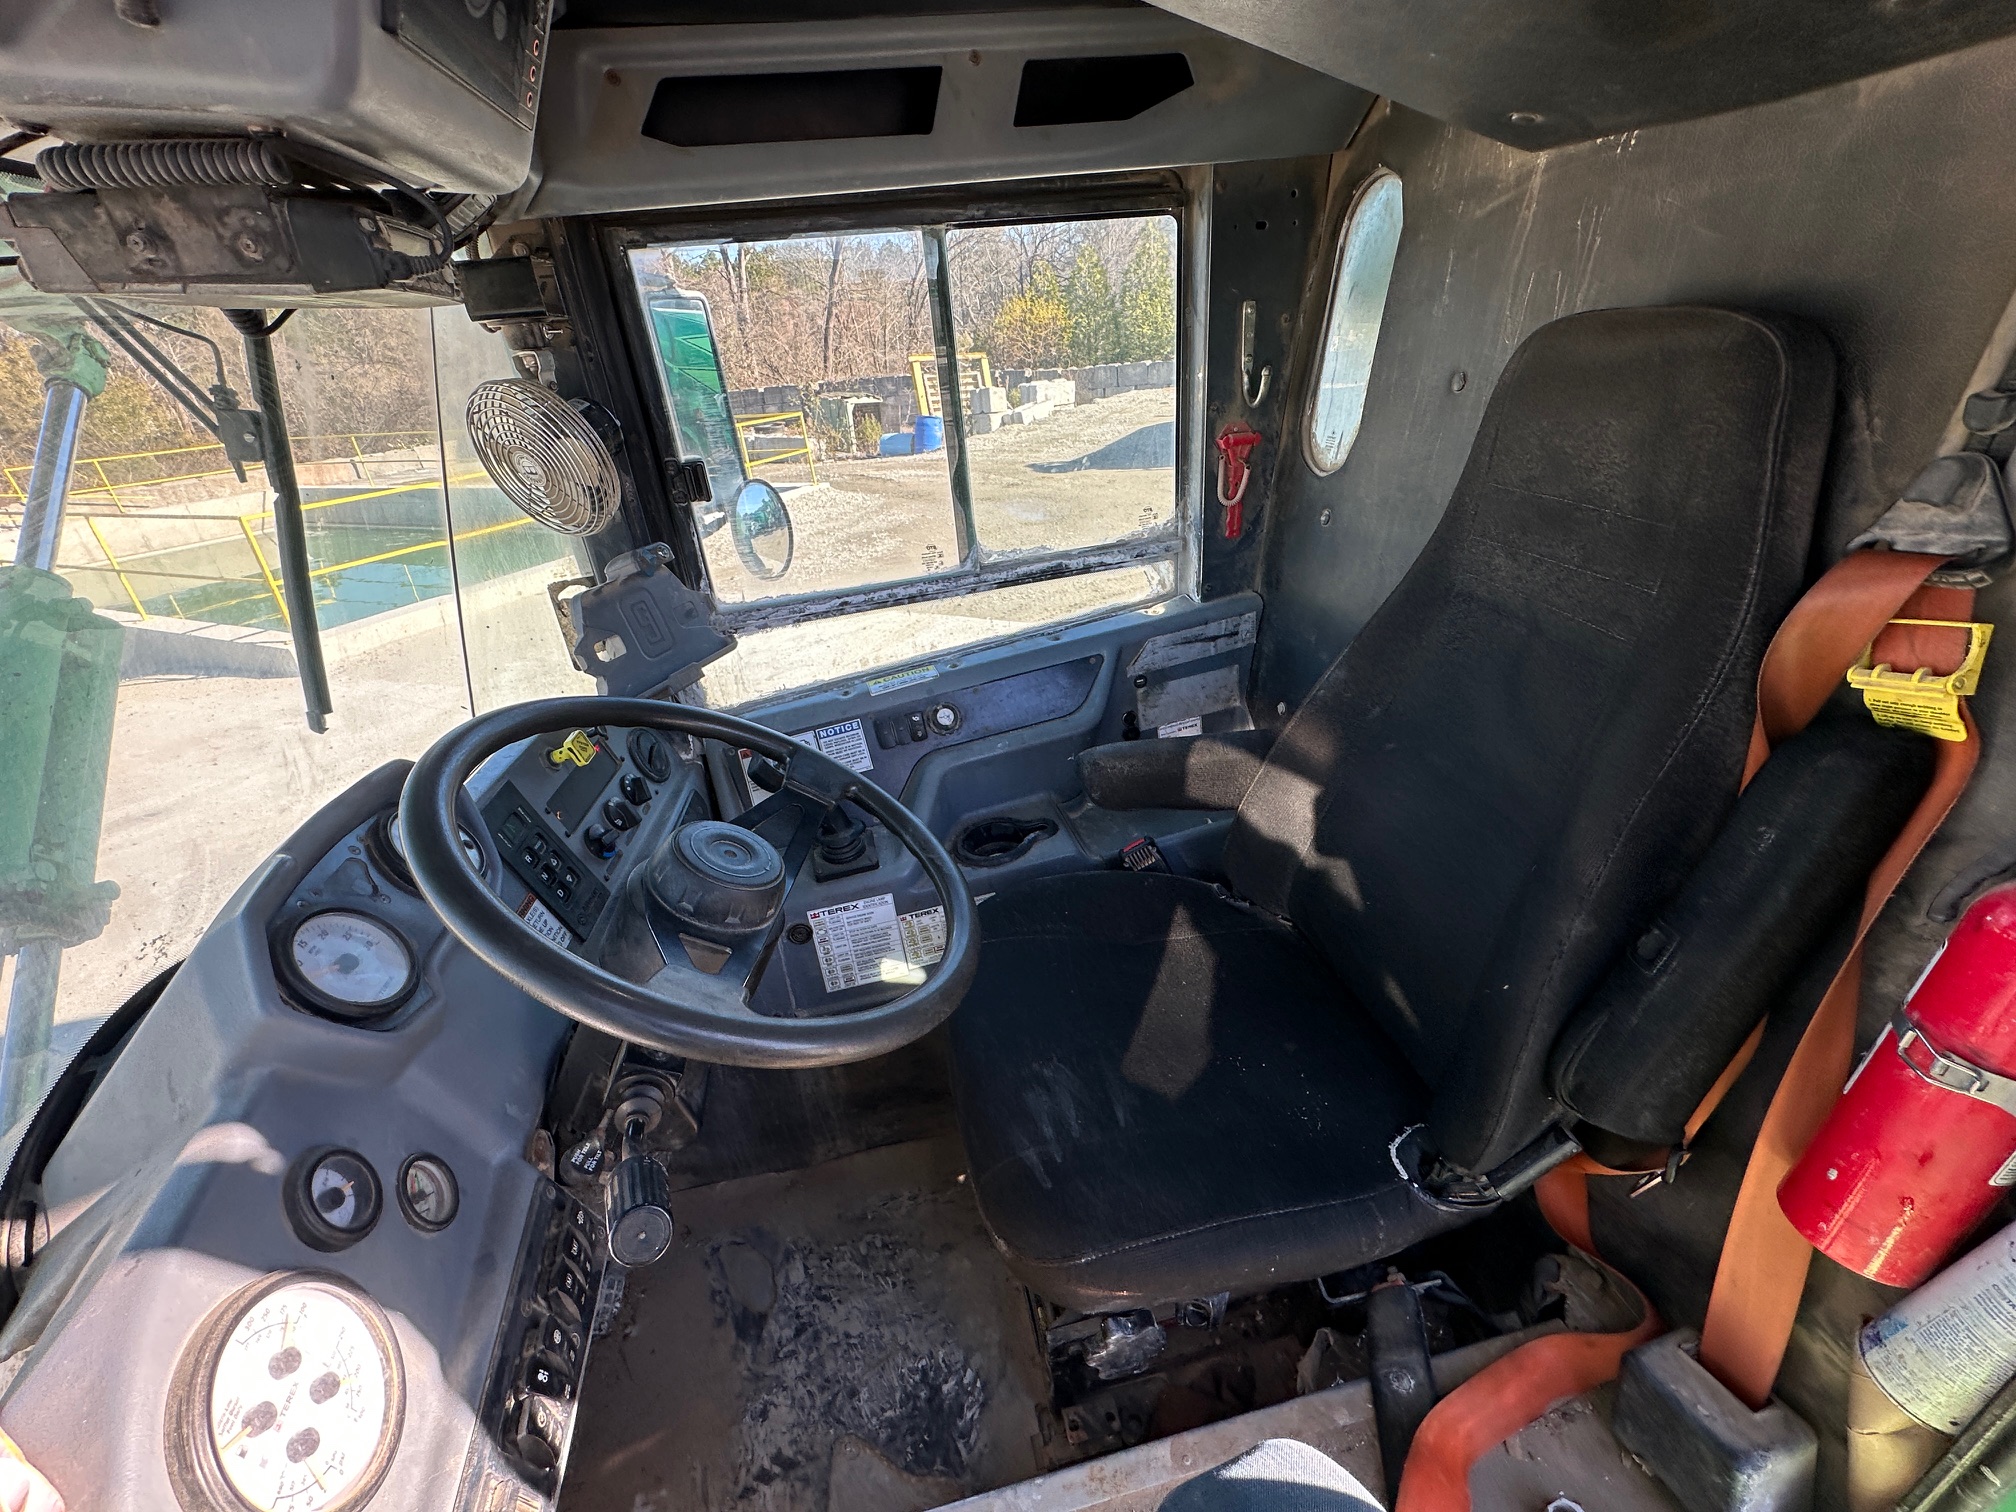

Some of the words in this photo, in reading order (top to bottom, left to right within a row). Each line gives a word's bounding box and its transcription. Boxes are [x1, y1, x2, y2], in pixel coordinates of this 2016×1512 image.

[883, 667, 930, 682] CAUTION
[819, 722, 859, 738] NOTICE
[525, 854, 533, 864] R
[541, 871, 549, 881] N
[557, 889, 564, 898] D
[517, 894, 535, 918] RNING
[820, 903, 859, 917] TEREX
[909, 907, 939, 919] TEREX
[532, 910, 545, 929] ETURN
[317, 929, 329, 940] 20
[343, 930, 353, 941] 25
[297, 939, 308, 949] 15
[363, 940, 374, 951] 30
[280, 1304, 288, 1315] 175
[299, 1302, 307, 1315] 100
[261, 1308, 271, 1322] 250
[245, 1316, 255, 1332] 300
[279, 1381, 299, 1417] TEREX
[306, 1495, 314, 1507] 50
